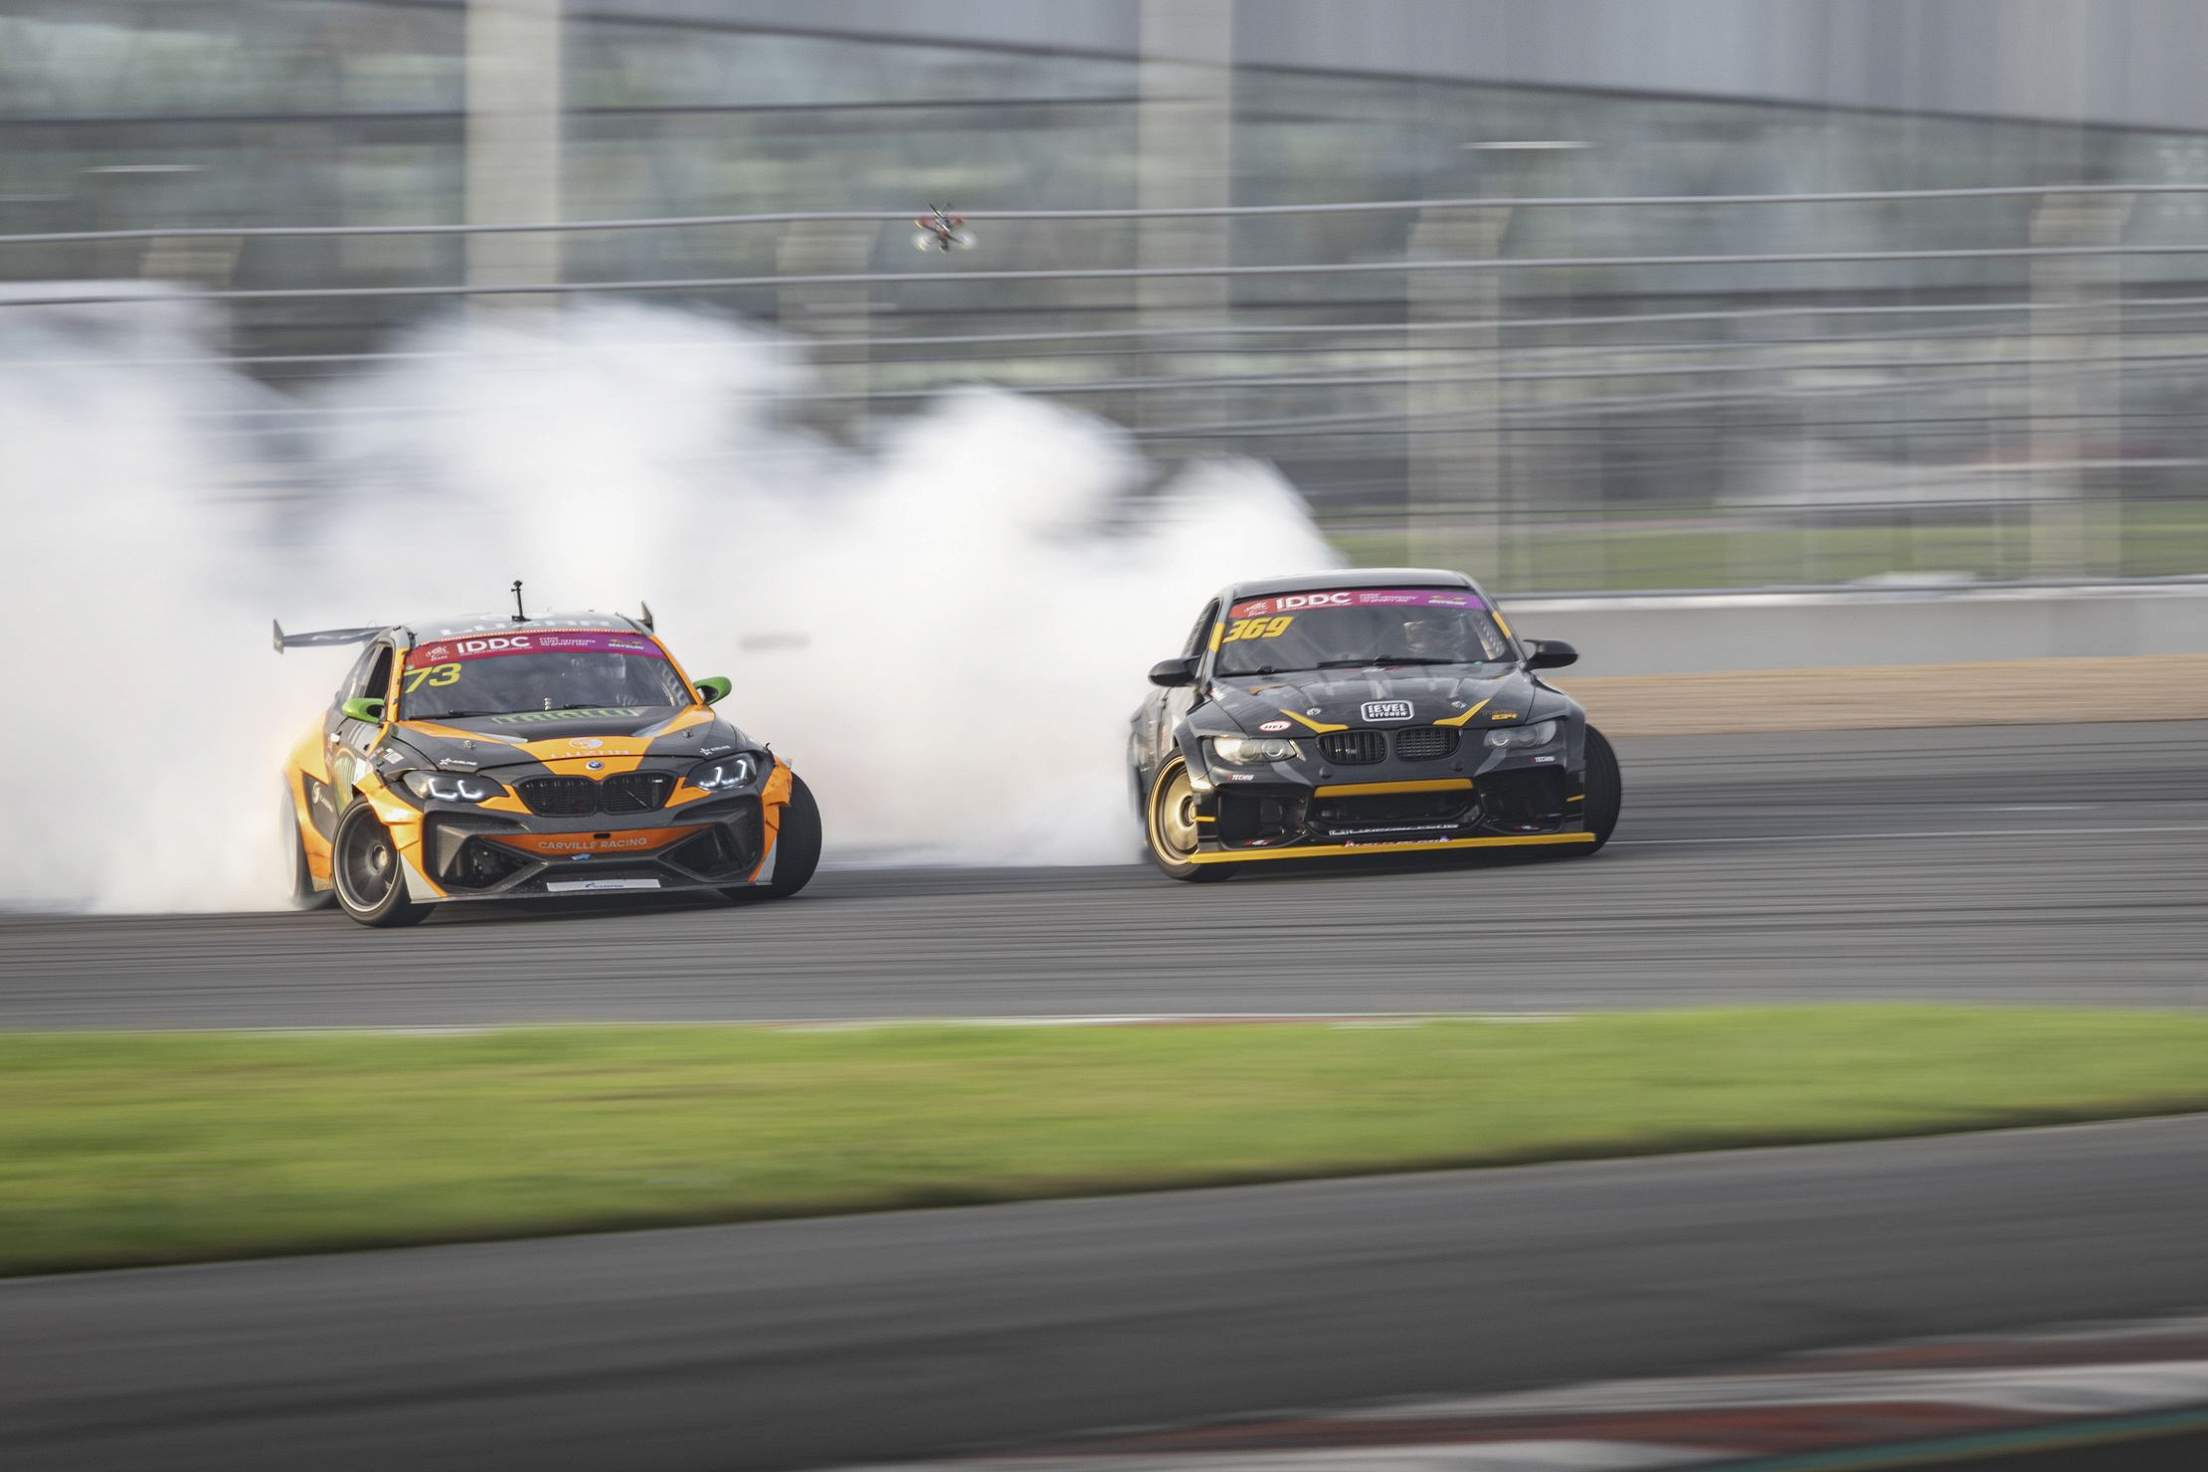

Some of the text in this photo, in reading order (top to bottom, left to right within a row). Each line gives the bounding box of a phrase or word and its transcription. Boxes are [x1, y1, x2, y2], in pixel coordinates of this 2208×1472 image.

[1275, 592, 1353, 609] IDDC
[1222, 615, 1296, 644] 369
[456, 636, 531, 654] IDDC
[403, 663, 462, 694] 73
[1367, 703, 1408, 714] LEVEL
[538, 837, 648, 850] CARVILLE RACING
